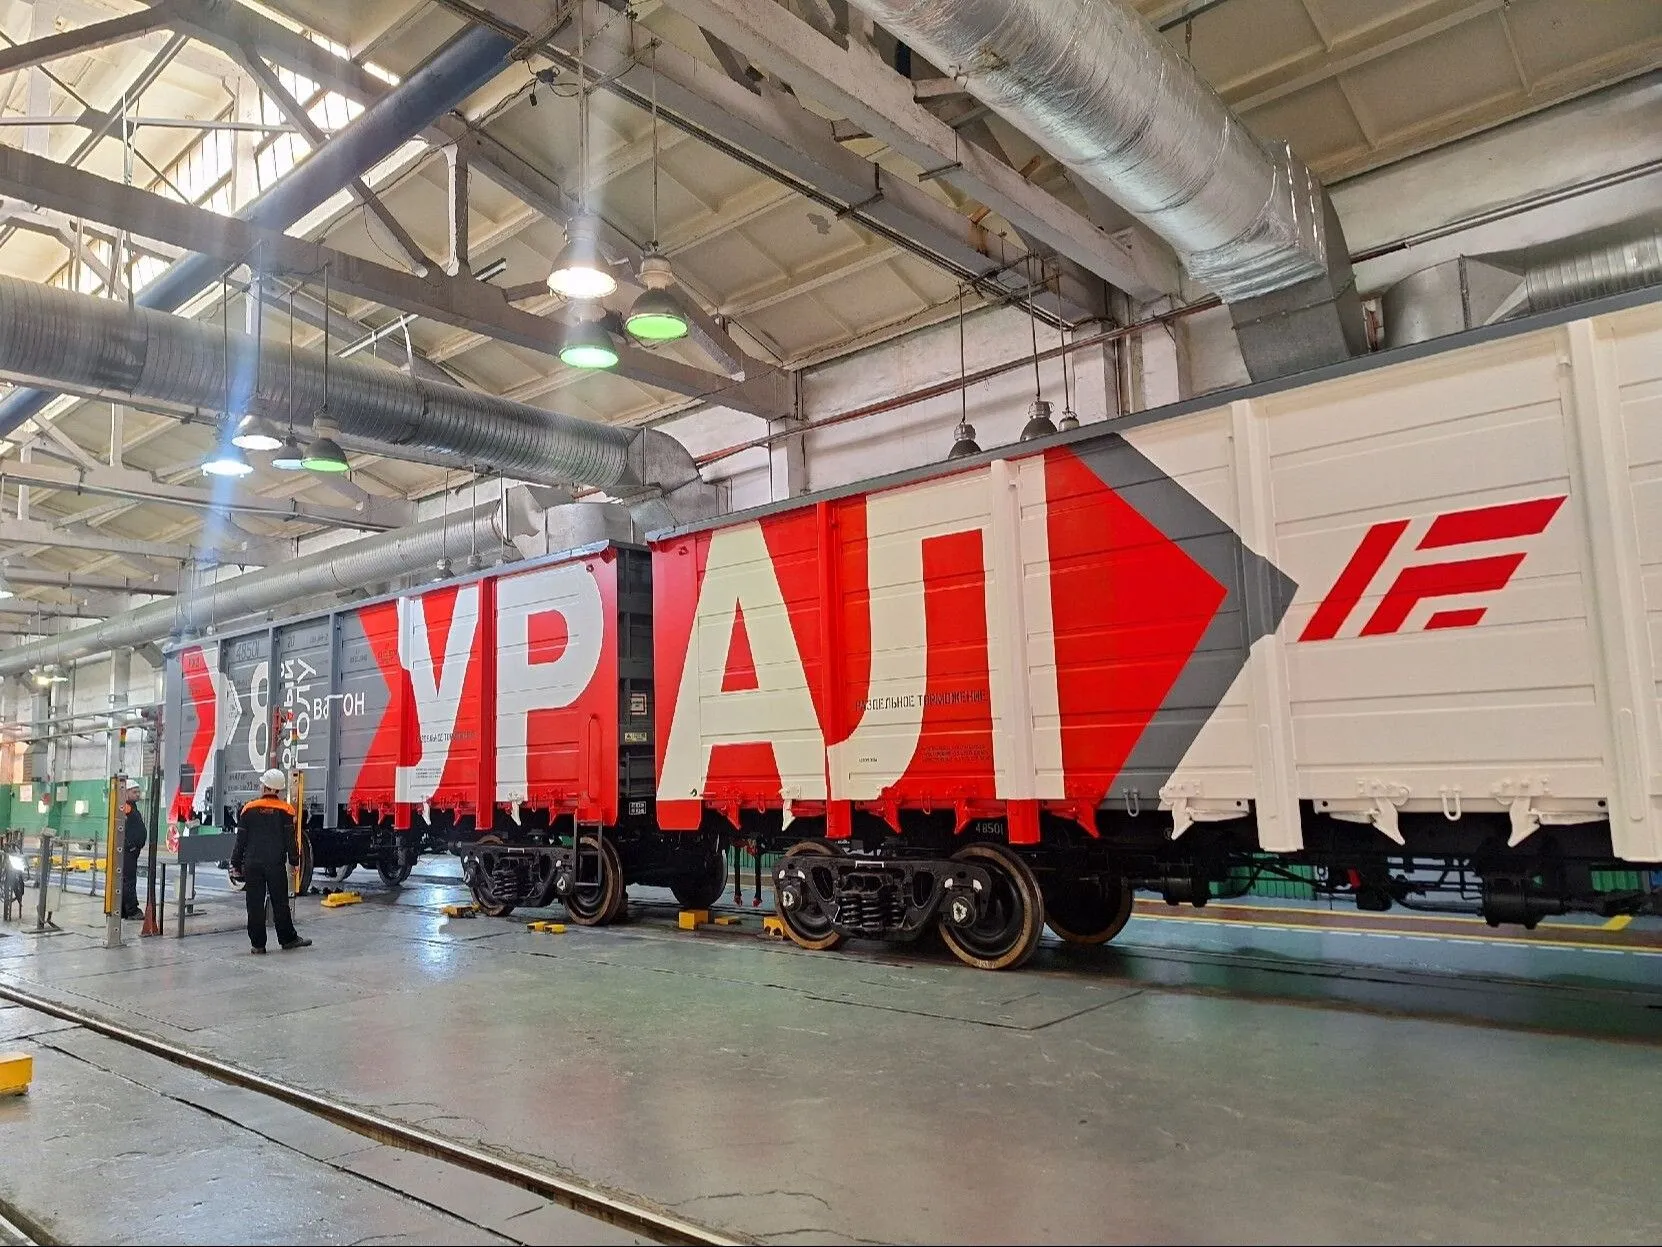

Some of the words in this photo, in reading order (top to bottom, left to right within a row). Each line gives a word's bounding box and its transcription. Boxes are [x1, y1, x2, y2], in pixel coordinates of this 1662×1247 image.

[249, 661, 269, 773] 8
[295, 658, 317, 769] ПОЛУ
[855, 694, 915, 712] РАЗДЕЛЬНОЕ
[918, 690, 985, 707] ТОРМОЖЕНИЕ
